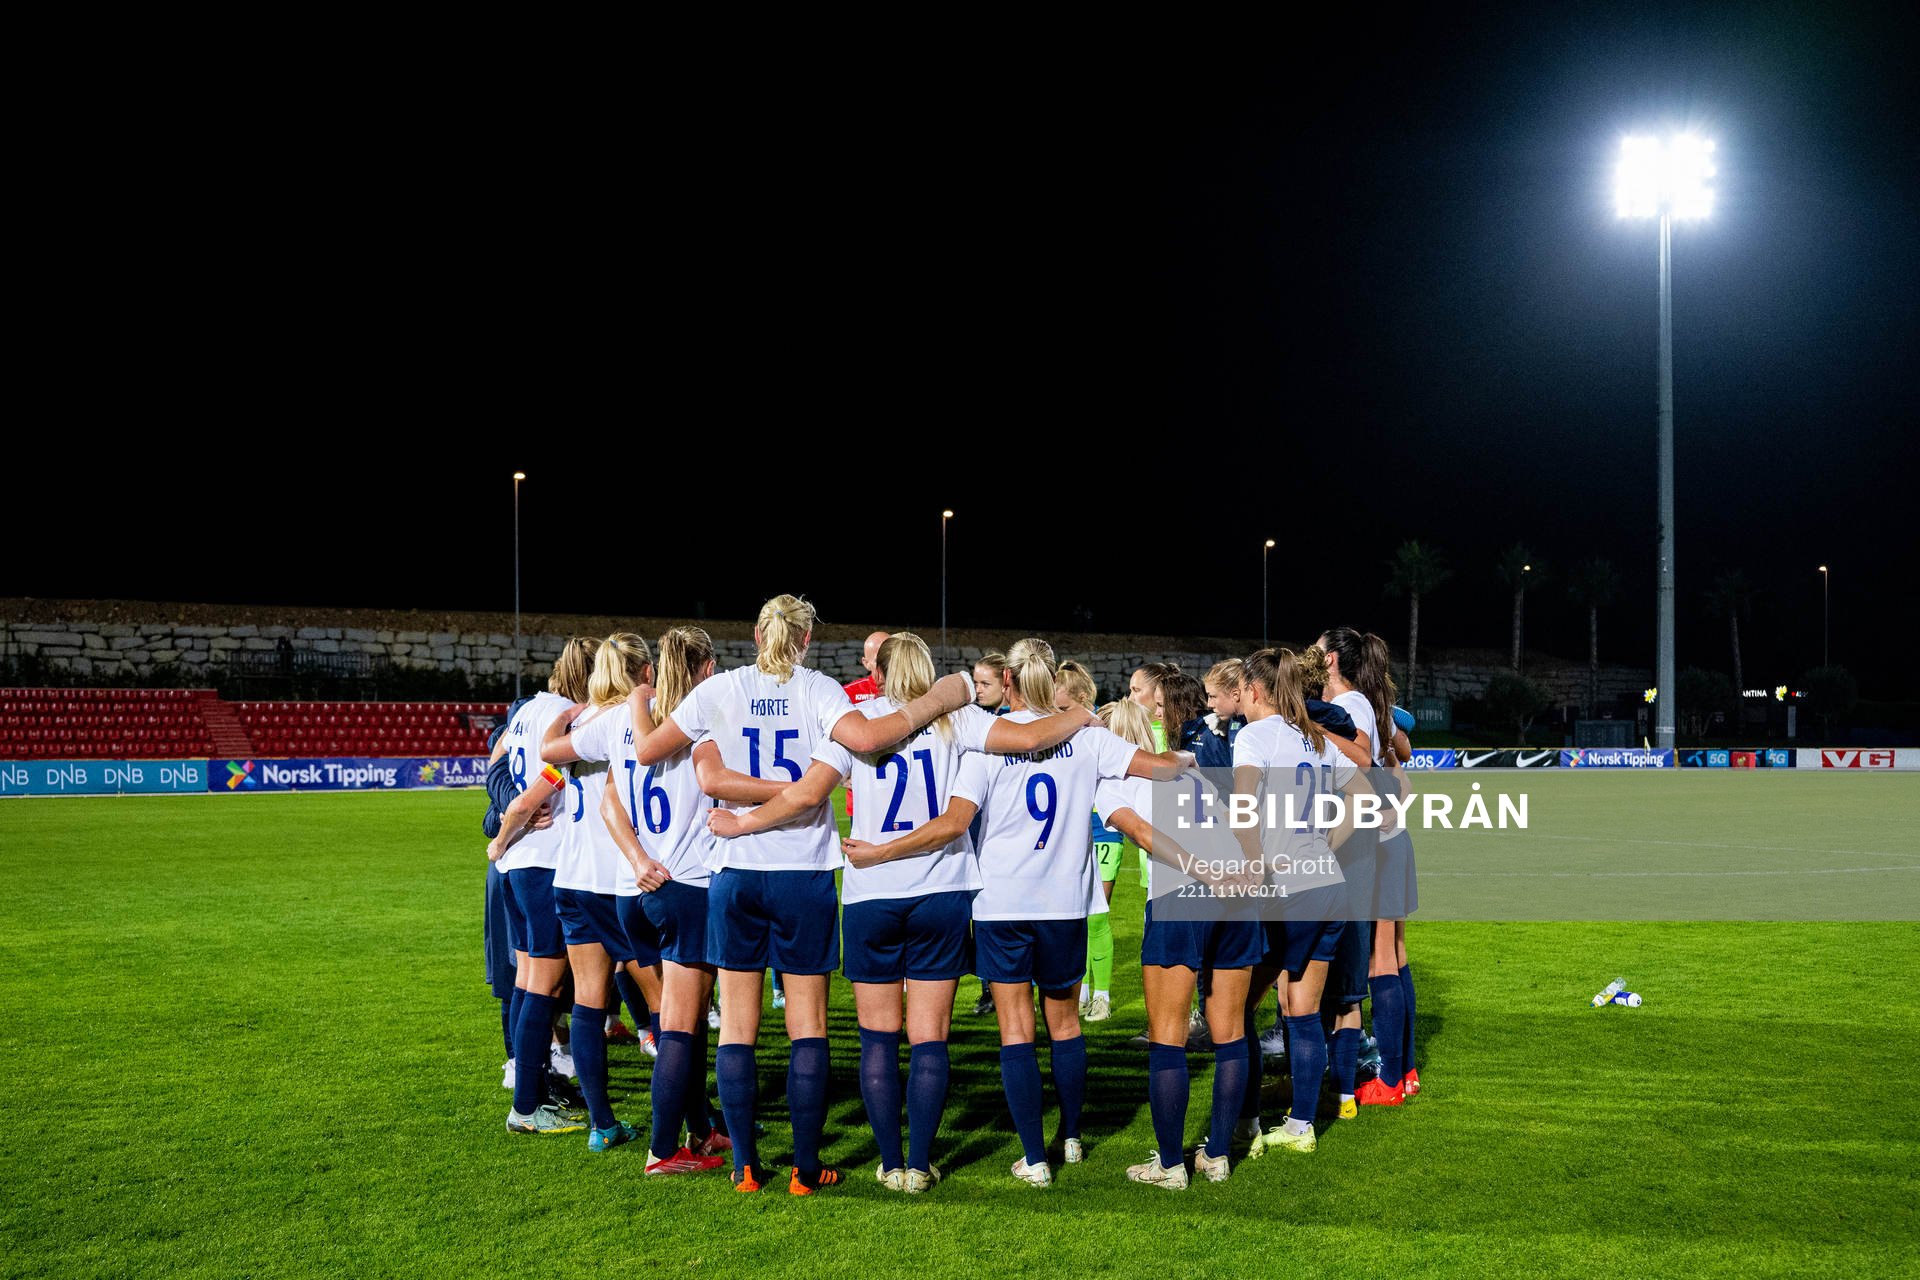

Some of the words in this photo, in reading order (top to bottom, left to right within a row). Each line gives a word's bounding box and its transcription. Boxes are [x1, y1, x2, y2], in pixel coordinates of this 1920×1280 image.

[751, 698, 789, 716] HØRTE
[443, 760, 463, 774] LA
[472, 758, 490, 773] N
[742, 727, 802, 783] 15
[1589, 752, 1621, 766] Norsk
[1623, 751, 1664, 768] Tipping
[1709, 752, 1727, 765] 5G
[1769, 752, 1787, 765] 5G
[1822, 751, 1895, 768] VG
[47, 763, 87, 790] DNB
[105, 763, 144, 789] DNB
[160, 762, 199, 788] DNB
[262, 763, 323, 785] Norsk
[324, 762, 397, 786] Tipping
[443, 775, 475, 784] CIUDAD
[624, 759, 671, 835] 16
[876, 749, 938, 833] 21
[1025, 773, 1057, 851] 9
[1094, 843, 1110, 865] 12
